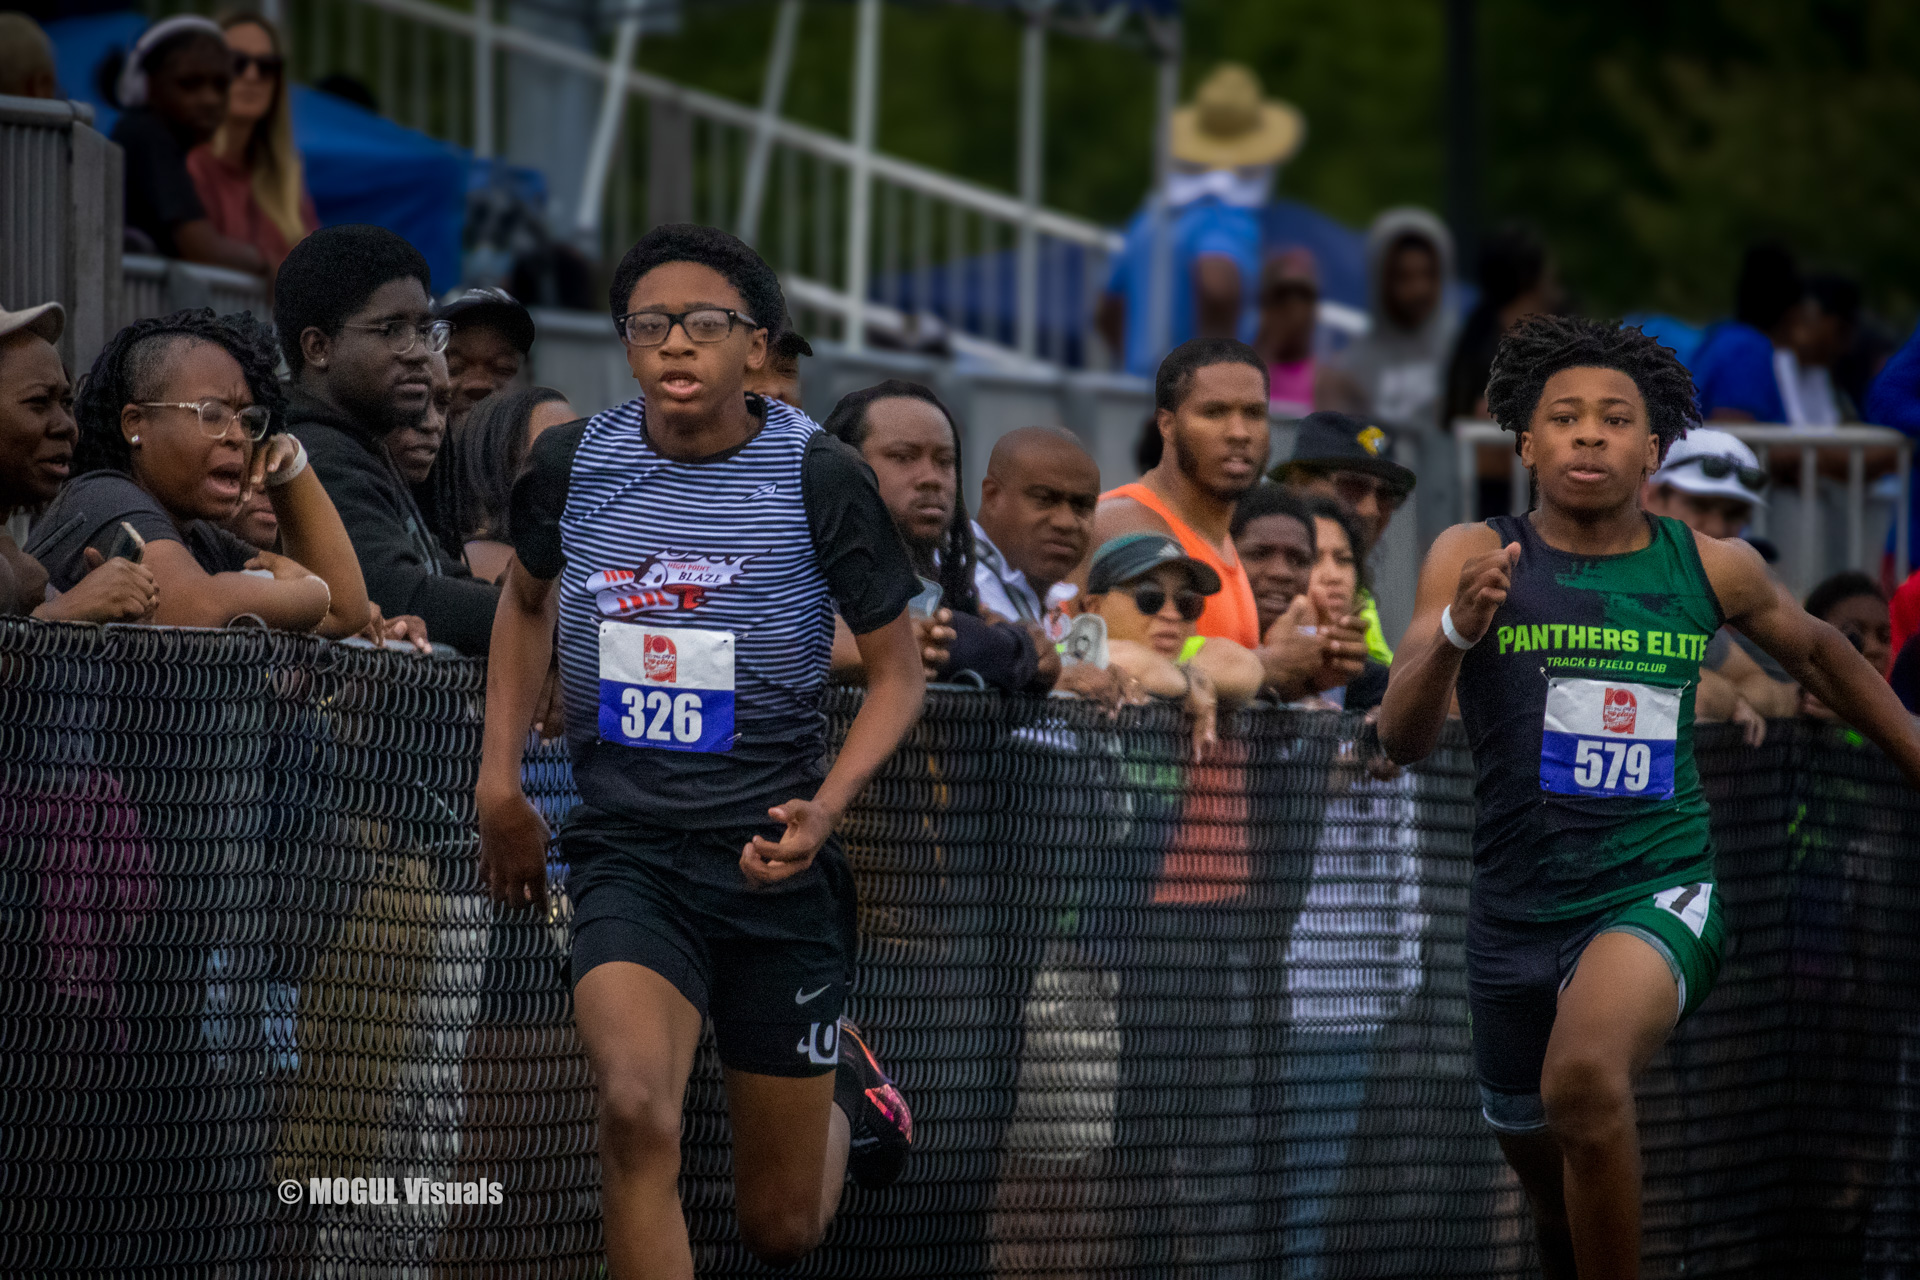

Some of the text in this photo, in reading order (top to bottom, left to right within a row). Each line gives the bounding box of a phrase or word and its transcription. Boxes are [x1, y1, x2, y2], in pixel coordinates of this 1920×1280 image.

[667, 561, 711, 572] HIGH POINT
[678, 571, 723, 584] BLAZE
[1497, 623, 1709, 662] PANTHERS ELITE
[1546, 656, 1668, 674] TRACK & FIELD CLUB
[621, 687, 703, 743] 326
[1573, 739, 1651, 792] 579
